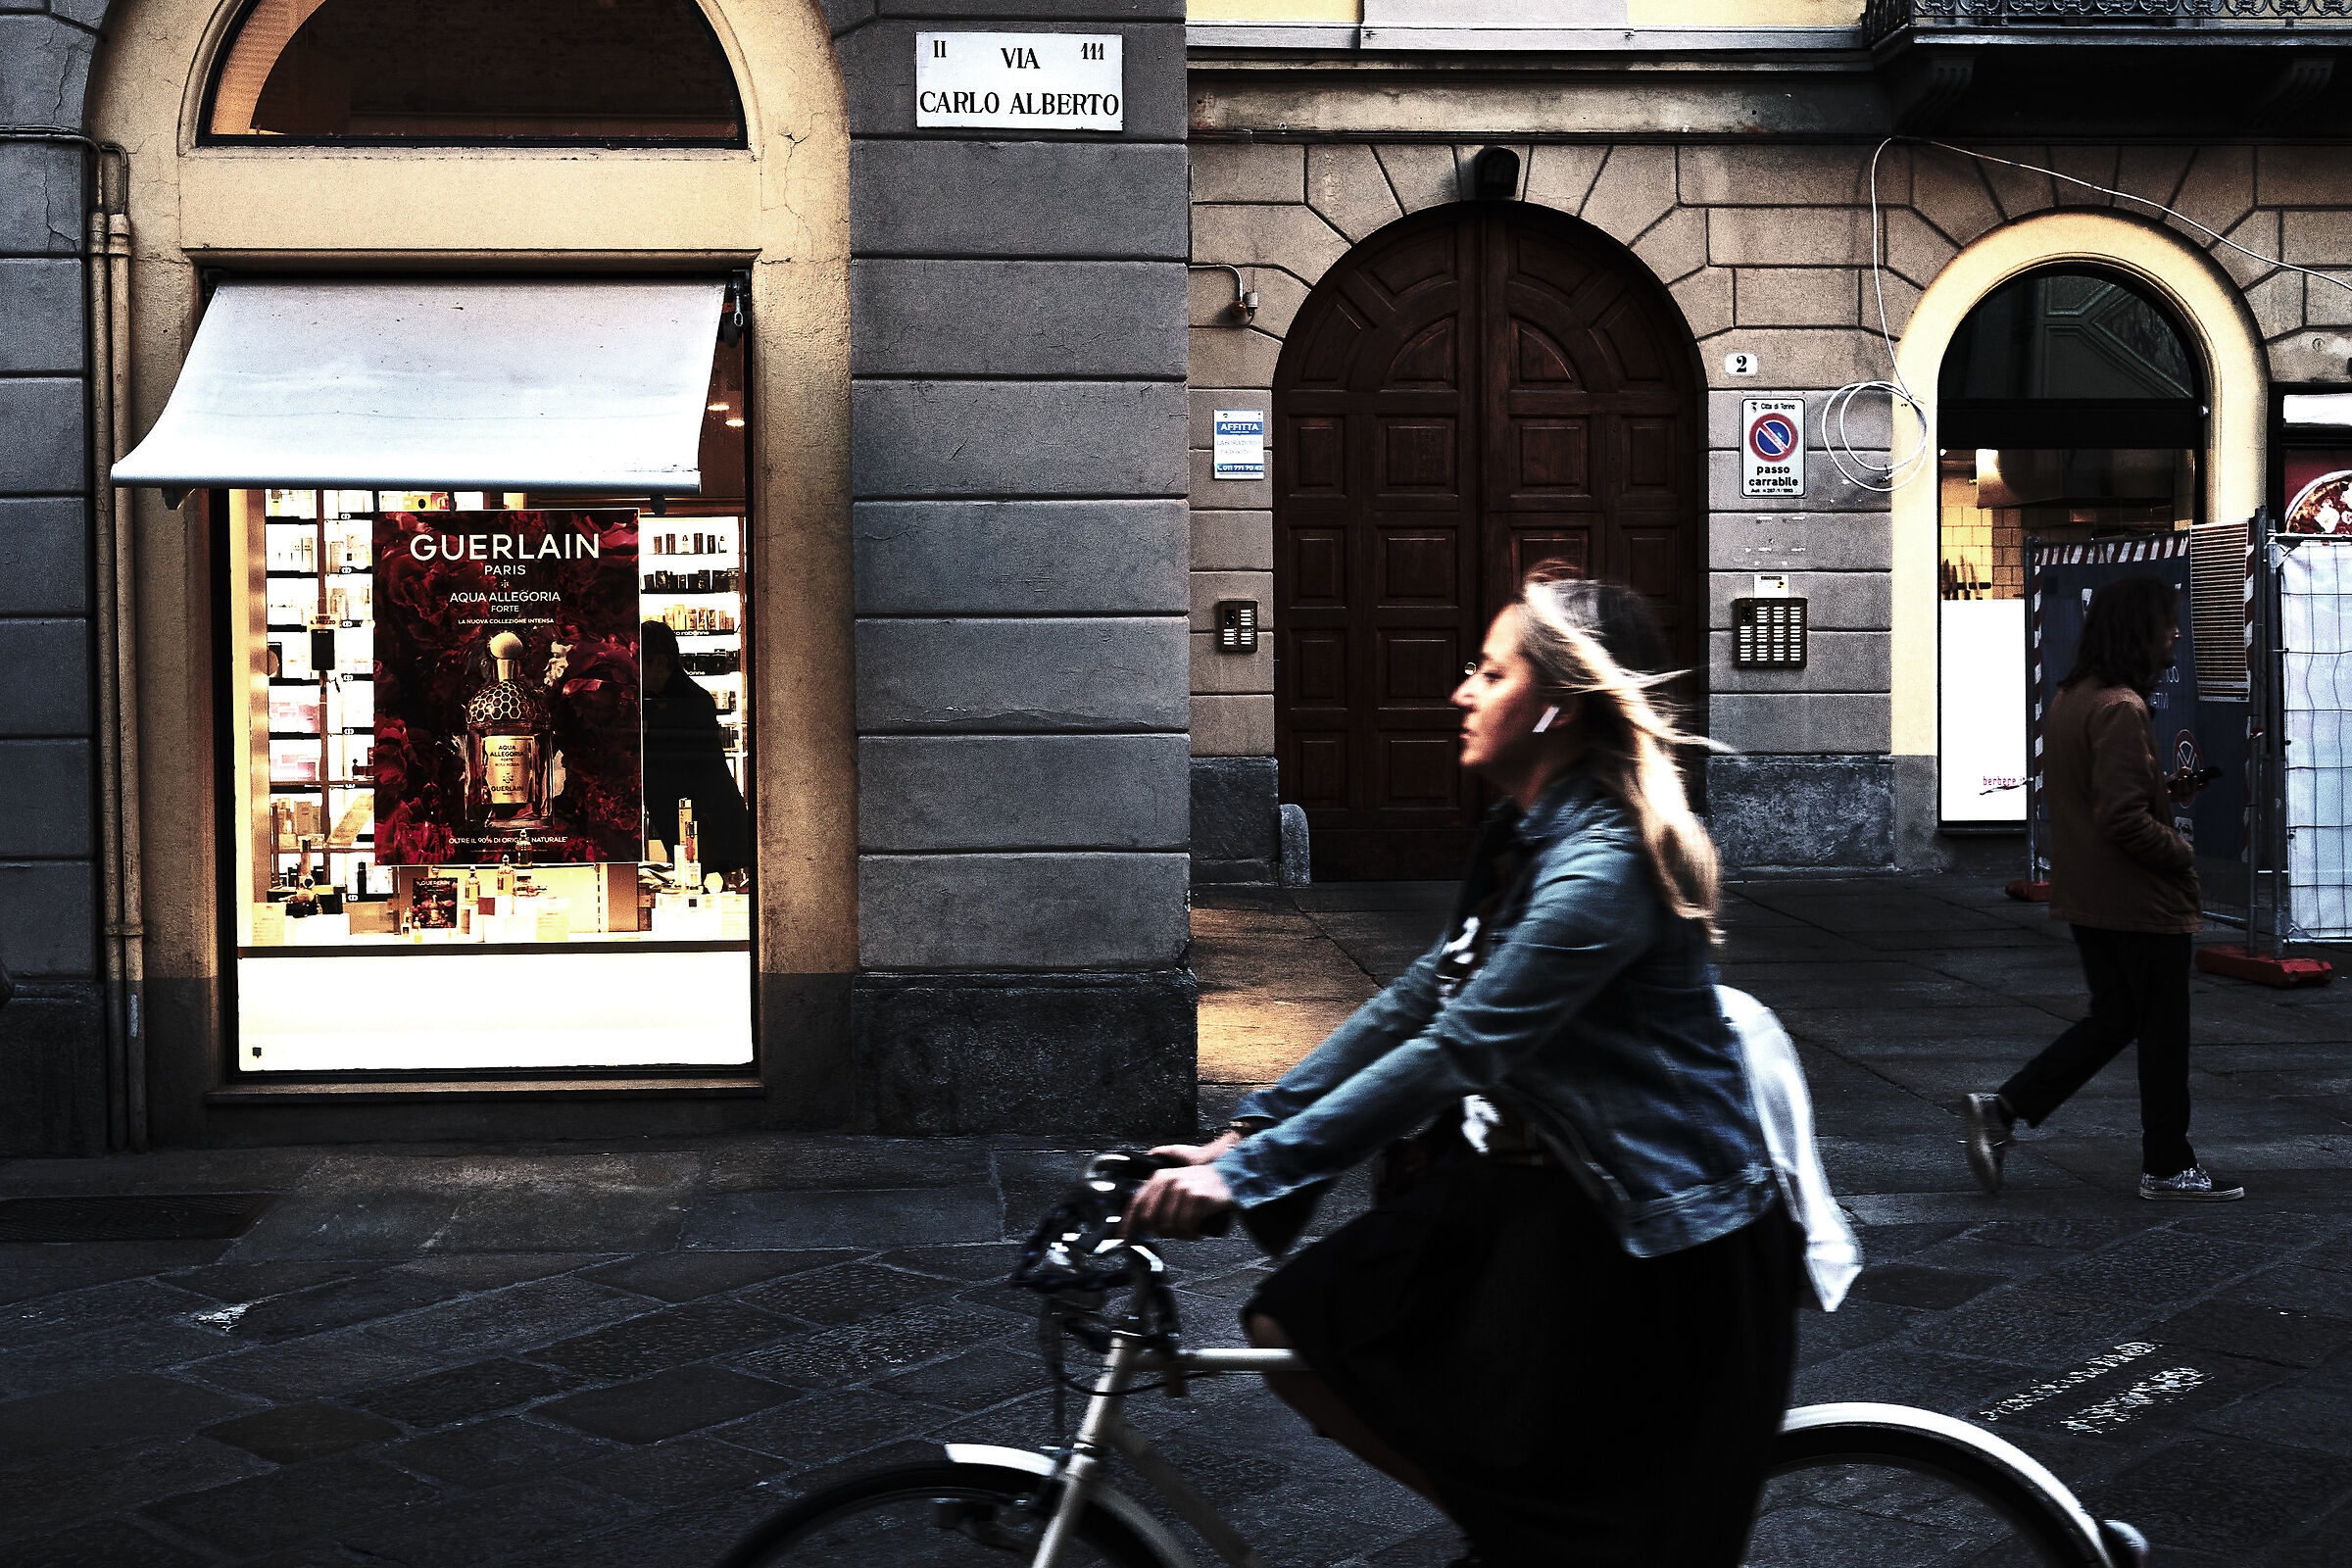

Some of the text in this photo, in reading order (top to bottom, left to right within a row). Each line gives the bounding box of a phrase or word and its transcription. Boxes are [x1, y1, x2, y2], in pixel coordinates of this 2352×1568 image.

[1001, 47, 1041, 69] VIA
[919, 90, 1119, 116] CARLO ALBERTO
[1736, 355, 1747, 373] 2
[1220, 422, 1259, 431] AFFITTA
[1756, 466, 1790, 475] passo
[1748, 477, 1798, 486] carrabile
[410, 533, 600, 562] GUERLAIN
[484, 564, 526, 575] PARIS
[450, 591, 561, 603] AQUA ALLEGORIA
